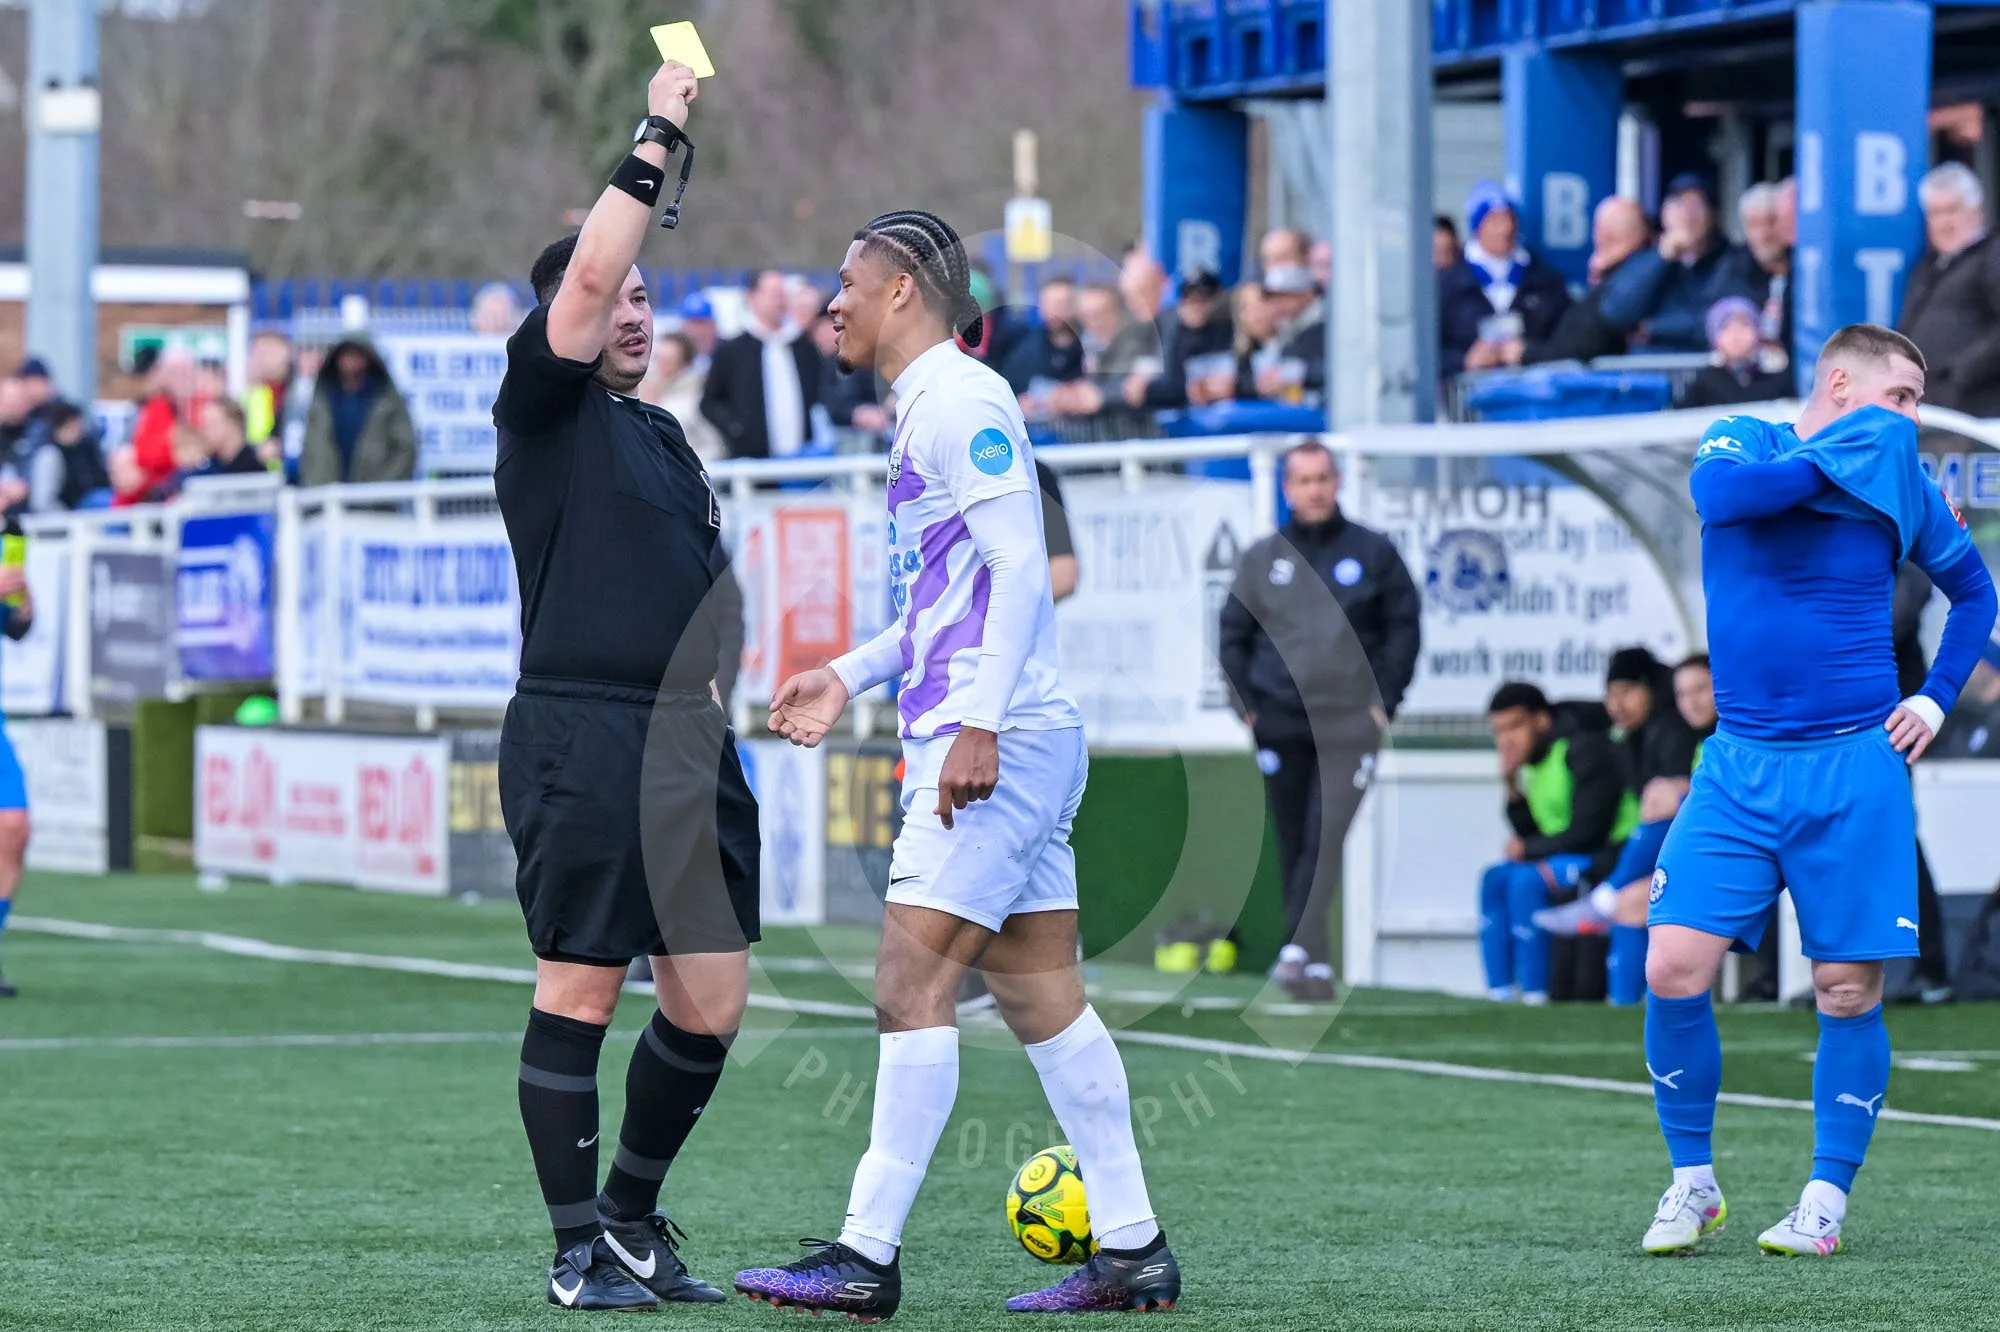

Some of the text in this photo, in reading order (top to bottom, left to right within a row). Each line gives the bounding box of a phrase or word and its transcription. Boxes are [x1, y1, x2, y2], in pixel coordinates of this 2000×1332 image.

[1542, 172, 1591, 249] B
[974, 443, 1009, 463] xero
[1429, 640, 1490, 675] work
